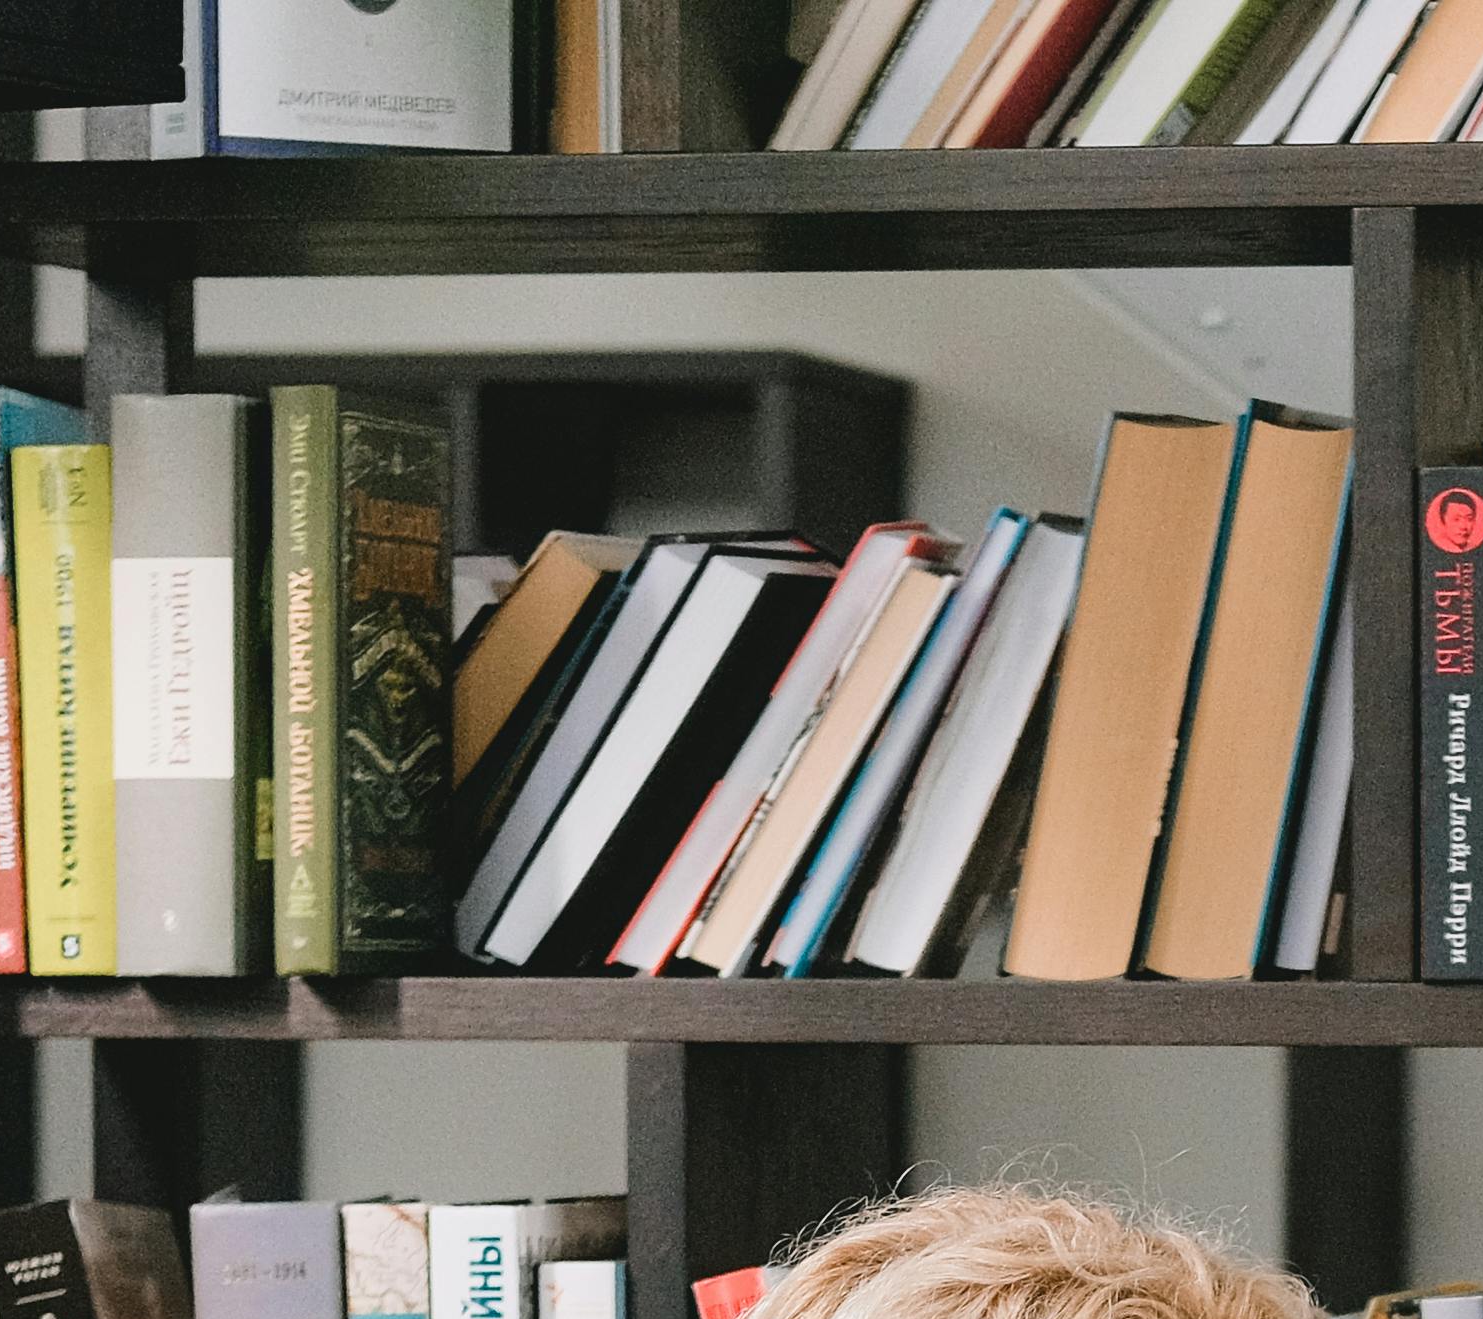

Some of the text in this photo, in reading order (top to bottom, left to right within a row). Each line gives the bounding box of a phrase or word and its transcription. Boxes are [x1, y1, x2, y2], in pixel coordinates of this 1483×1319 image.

[1435, 562, 1461, 674] ТЬМЫ
[1444, 693, 1472, 964] Ричард Ллойд Пэрри
